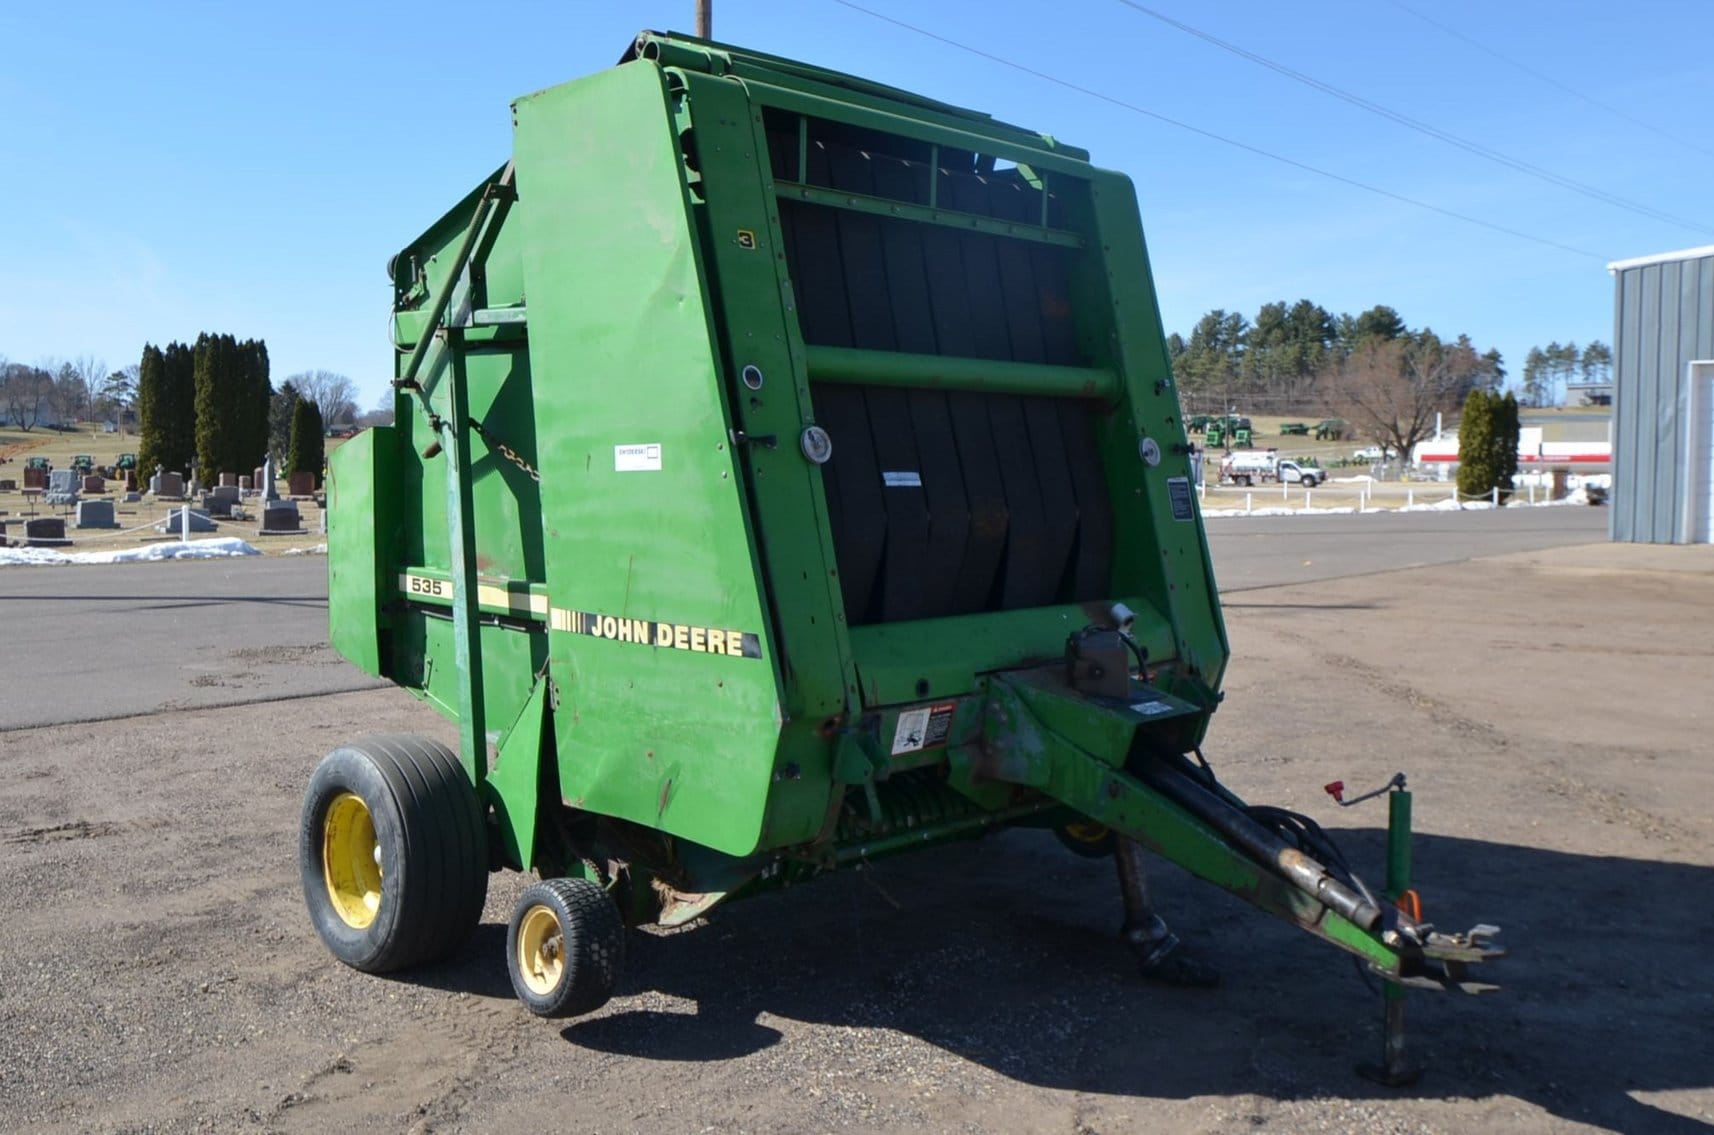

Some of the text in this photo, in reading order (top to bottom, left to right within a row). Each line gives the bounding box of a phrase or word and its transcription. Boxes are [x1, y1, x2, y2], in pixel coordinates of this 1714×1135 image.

[411, 577, 442, 595] 535
[591, 614, 743, 656] JOHN DEERE
